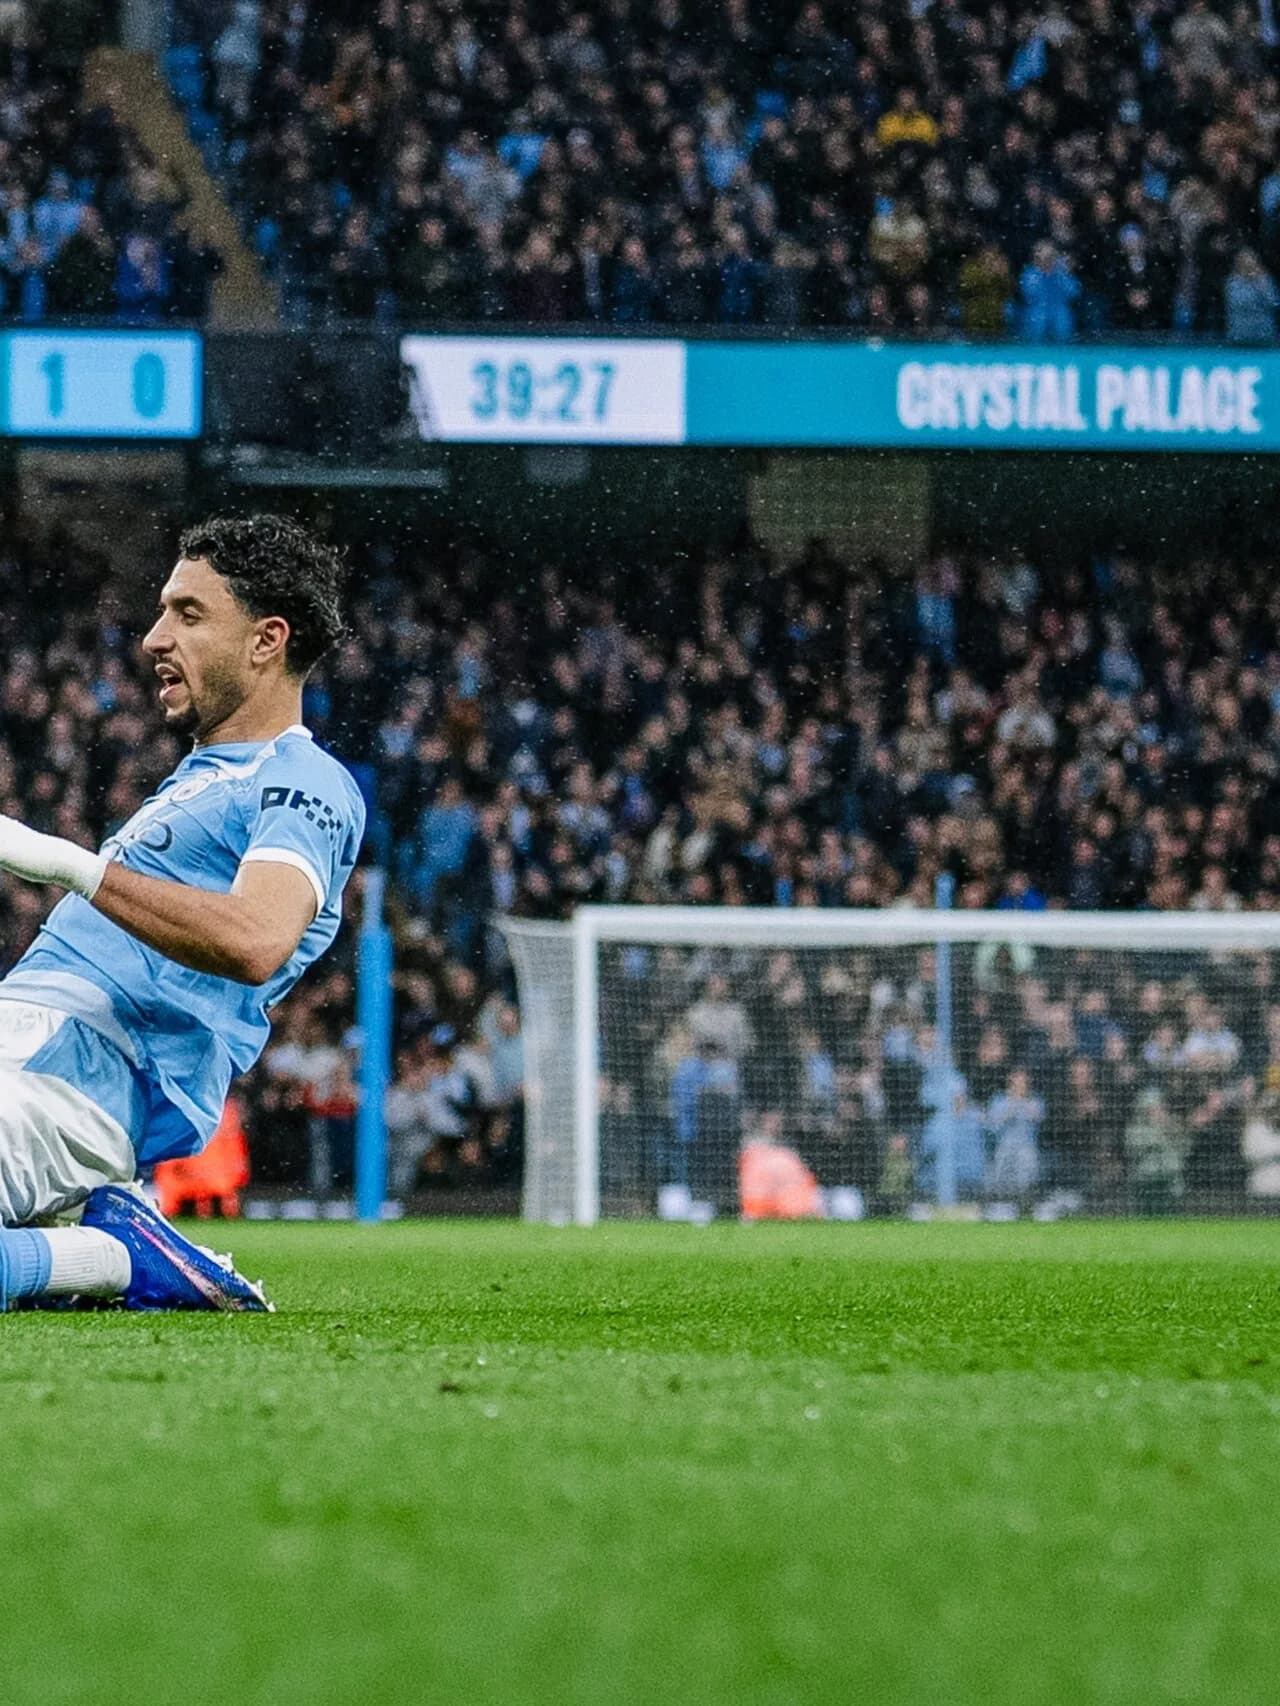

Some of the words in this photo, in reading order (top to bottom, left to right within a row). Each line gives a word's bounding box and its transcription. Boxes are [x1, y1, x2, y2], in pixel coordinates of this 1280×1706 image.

[40, 351, 64, 418] 1
[132, 351, 166, 419] 0
[472, 360, 616, 421] 39:27
[897, 362, 1087, 430] CRYSTAL
[1096, 365, 1261, 433] PALACE
